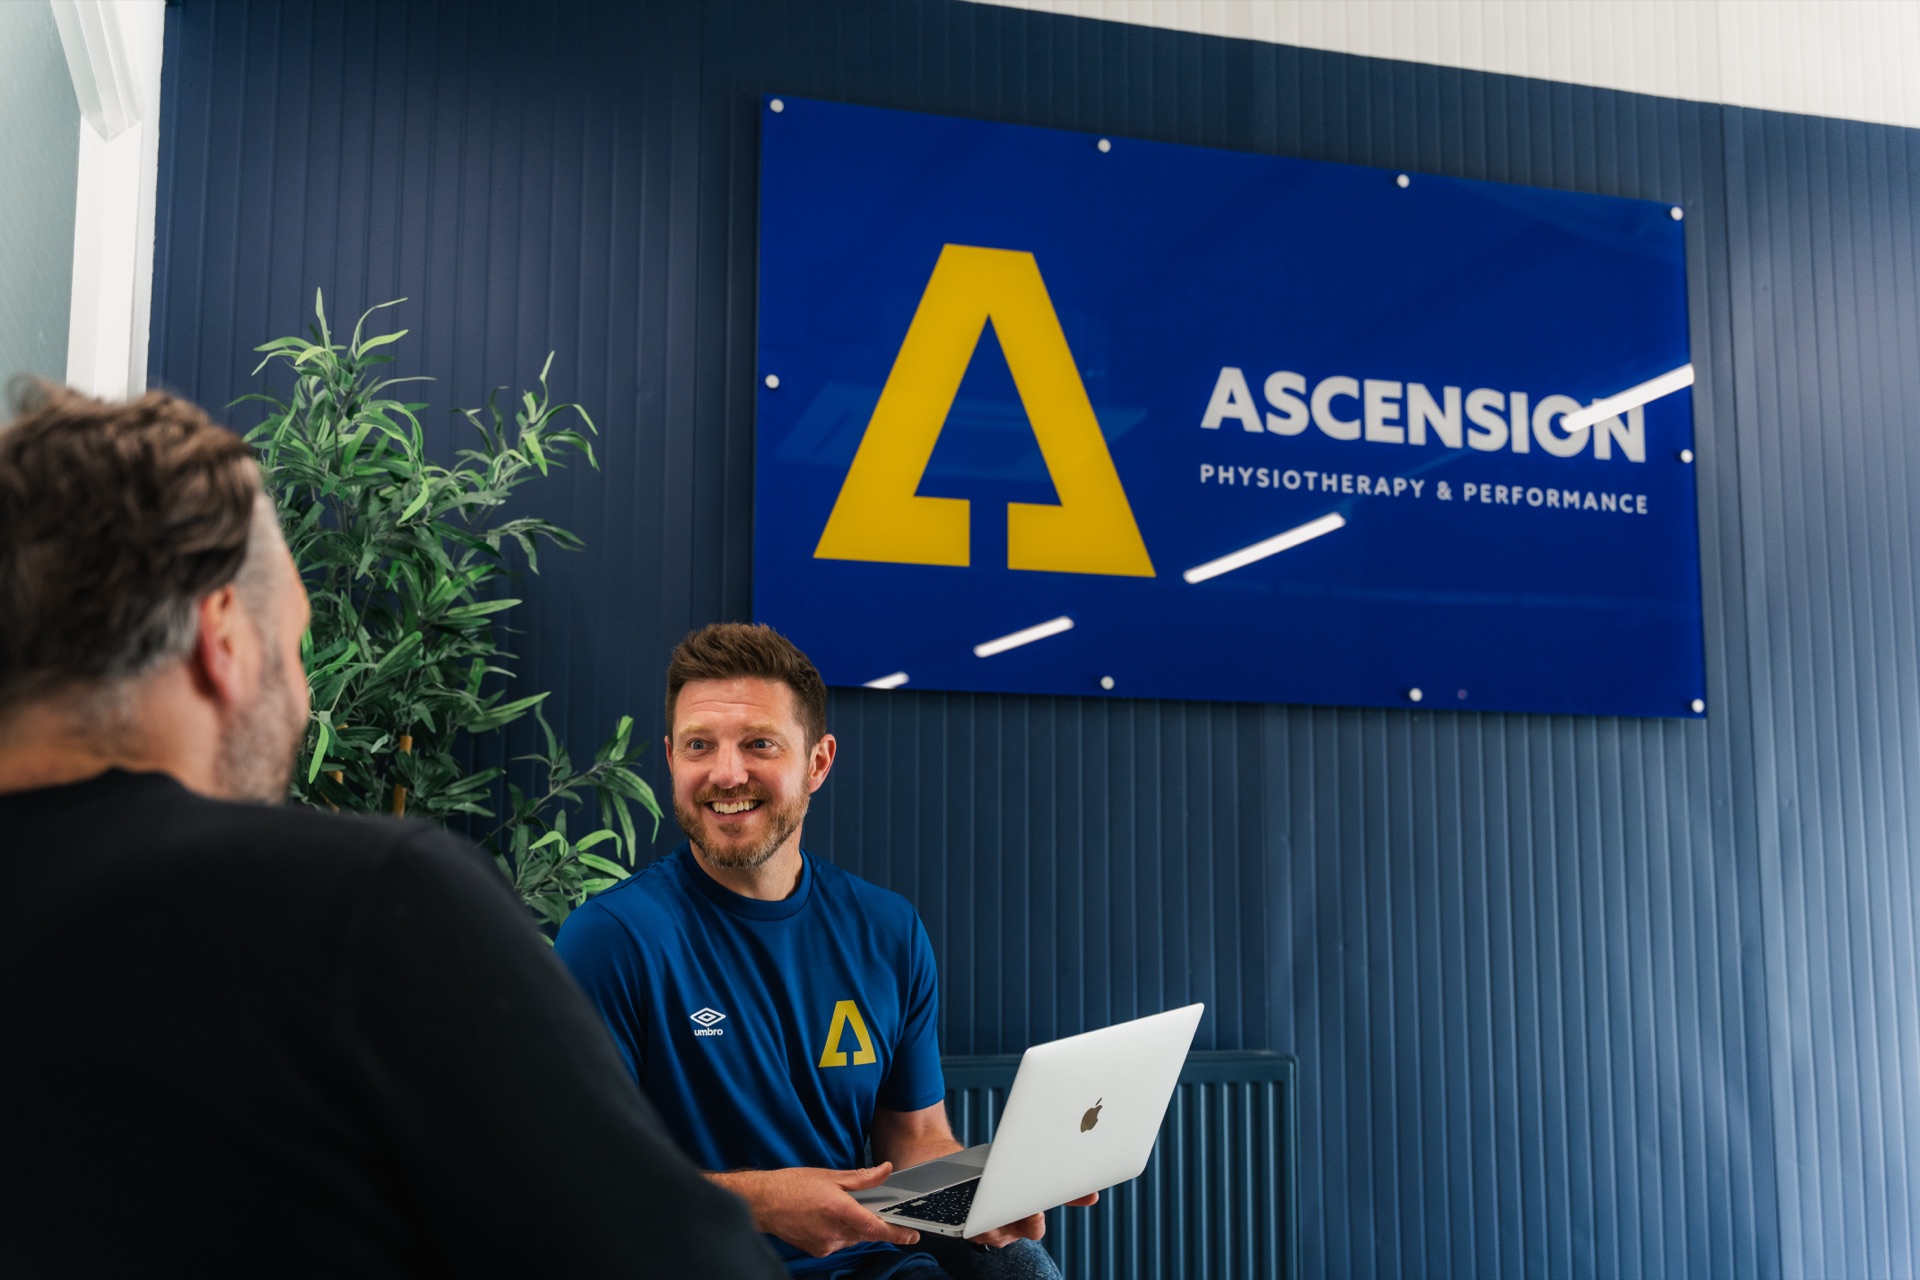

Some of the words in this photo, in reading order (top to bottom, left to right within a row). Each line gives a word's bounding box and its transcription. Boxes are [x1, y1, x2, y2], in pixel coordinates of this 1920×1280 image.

[1200, 366, 1647, 464] ASCENSION
[1200, 464, 1424, 498] PHYSIOTHERAPY
[1437, 481, 1452, 500] &
[1463, 483, 1648, 514] PERFORMANCE
[694, 1027, 724, 1037] umbro
